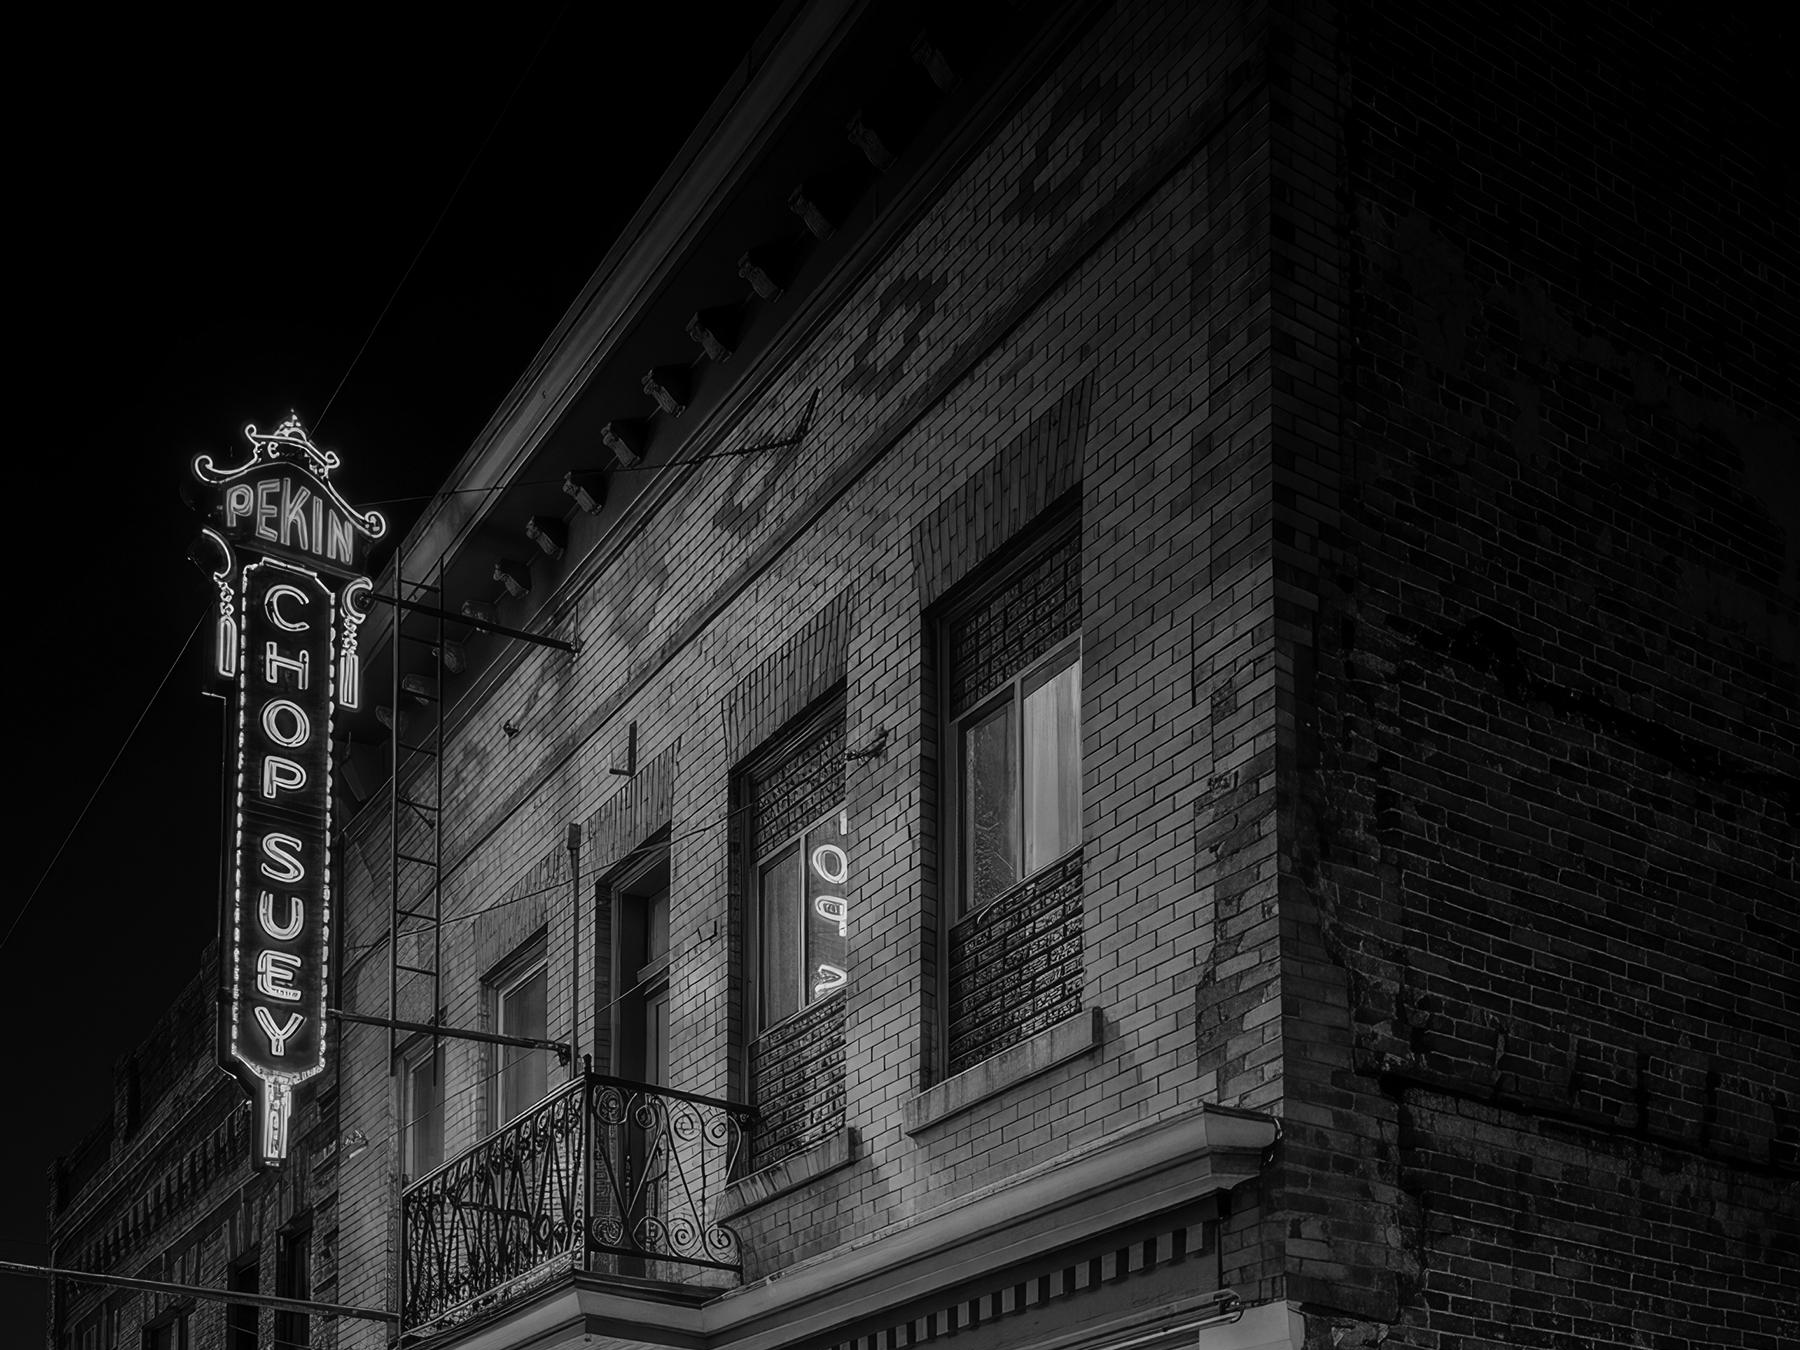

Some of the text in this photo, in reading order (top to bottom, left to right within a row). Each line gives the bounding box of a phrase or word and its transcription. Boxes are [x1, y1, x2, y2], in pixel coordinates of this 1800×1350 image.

[227, 477, 353, 565] PEKIN
[254, 584, 311, 1056] CHOP SUEY
